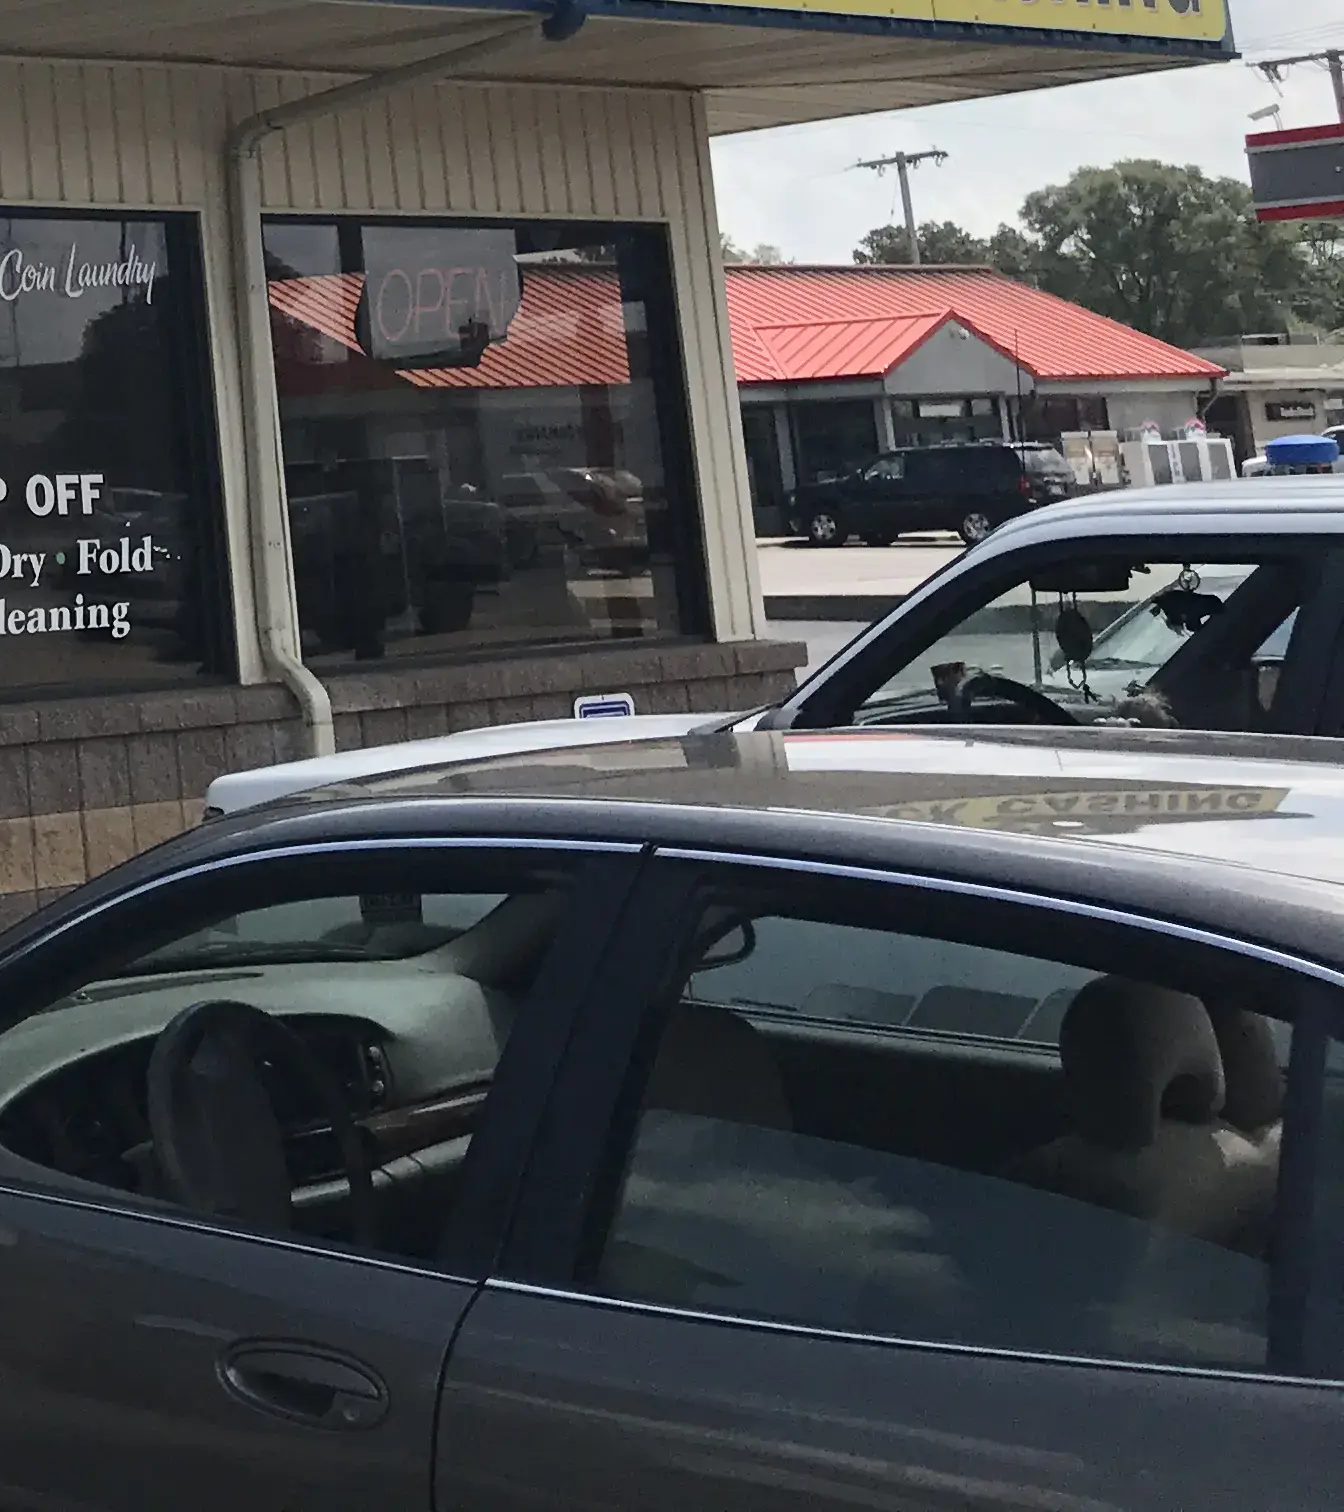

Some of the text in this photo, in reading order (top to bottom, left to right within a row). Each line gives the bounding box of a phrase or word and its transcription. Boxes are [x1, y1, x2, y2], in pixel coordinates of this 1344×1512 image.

[65, 243, 157, 305] Laundry
[378, 267, 508, 341] OPEN
[25, 473, 104, 517] OFF
[76, 535, 154, 575] Fold
